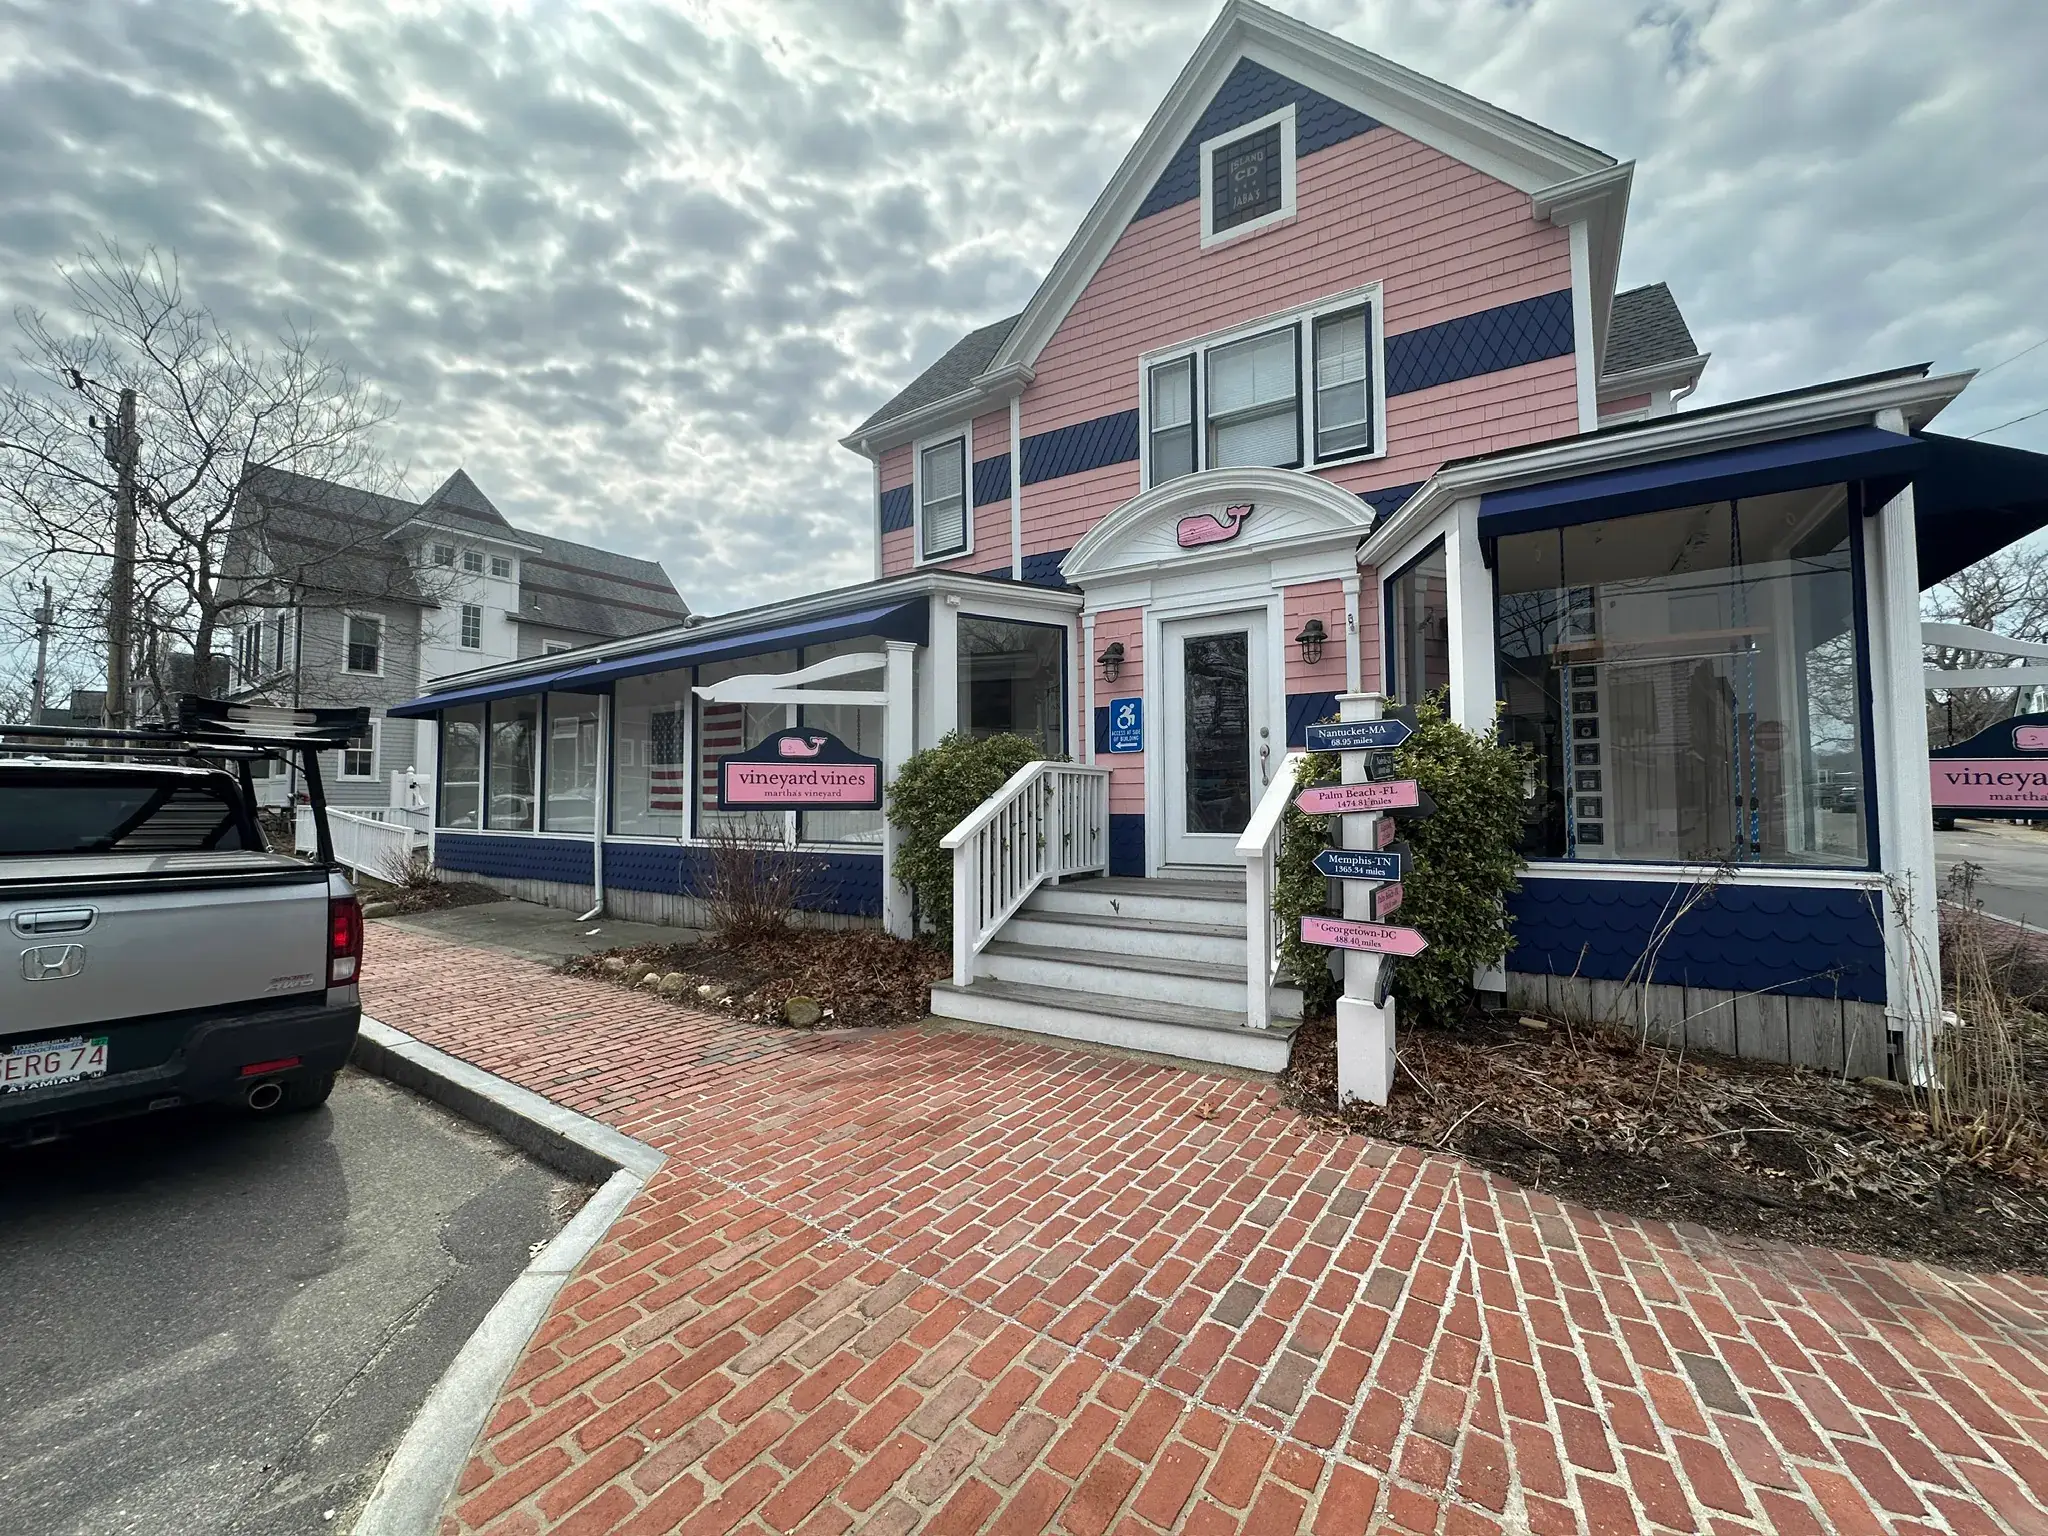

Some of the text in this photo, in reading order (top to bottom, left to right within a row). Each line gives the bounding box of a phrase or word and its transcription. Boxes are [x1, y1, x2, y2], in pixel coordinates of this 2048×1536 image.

[1230, 152, 1263, 174] ISLAND
[1235, 166, 1258, 181] CD
[1318, 725, 1386, 738] Nantucket-MA
[1331, 739, 1352, 747] 68.95
[739, 769, 866, 789] vineyard vines
[764, 789, 842, 799] martha's vineyard
[1319, 792, 1343, 801] Palm
[1346, 788, 1376, 799] Beach
[1328, 854, 1391, 867] Memphis-TN
[1334, 865, 1385, 876] 1365.34 miles
[1321, 924, 1396, 940] Georgetown-DC
[1334, 935, 1381, 948] 488.40 miles
[0, 1052, 60, 1081] ERG
[70, 1046, 103, 1070] 74
[7, 1075, 80, 1093] ATAMIAN
